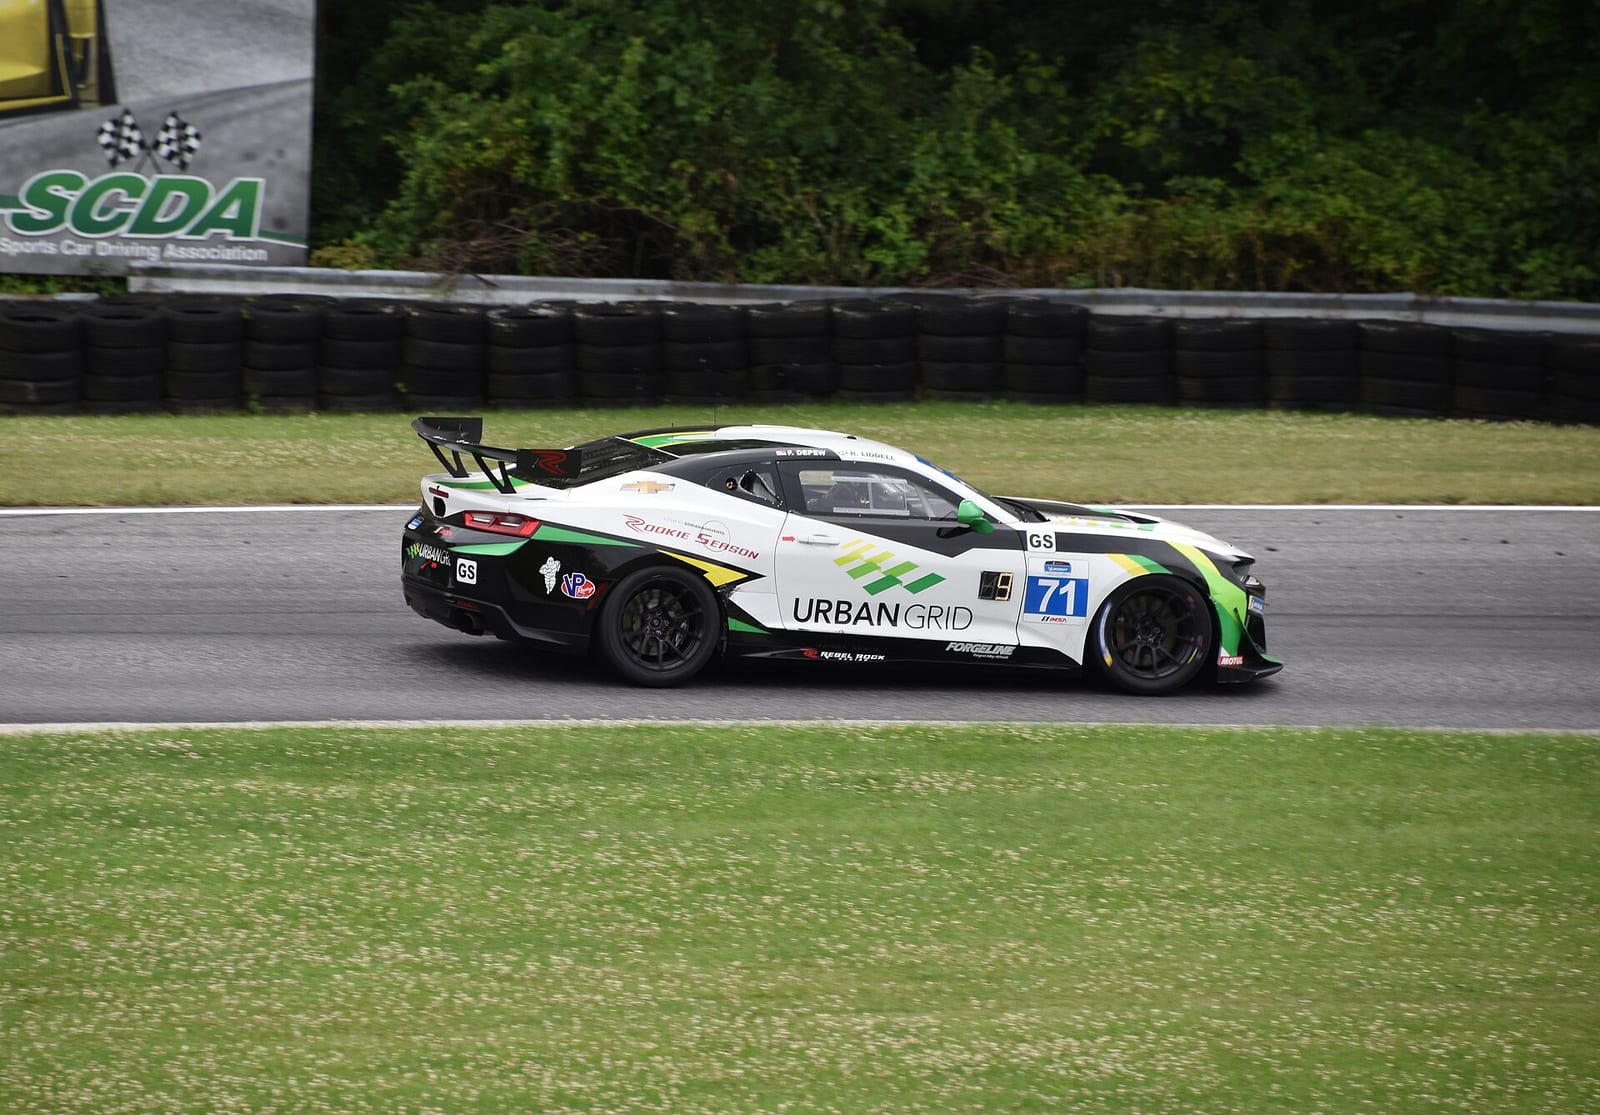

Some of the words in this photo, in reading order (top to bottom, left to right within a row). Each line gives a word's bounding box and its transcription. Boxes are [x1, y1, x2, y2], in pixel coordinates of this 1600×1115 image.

[5, 169, 264, 241] SCDA
[0, 237, 58, 256] Sports
[60, 240, 93, 256] Car
[95, 241, 161, 261] Driving
[163, 243, 268, 261] Association
[1029, 533, 1054, 549] GS
[458, 562, 476, 580] GS
[562, 572, 587, 598] VP
[1038, 578, 1076, 616] 71
